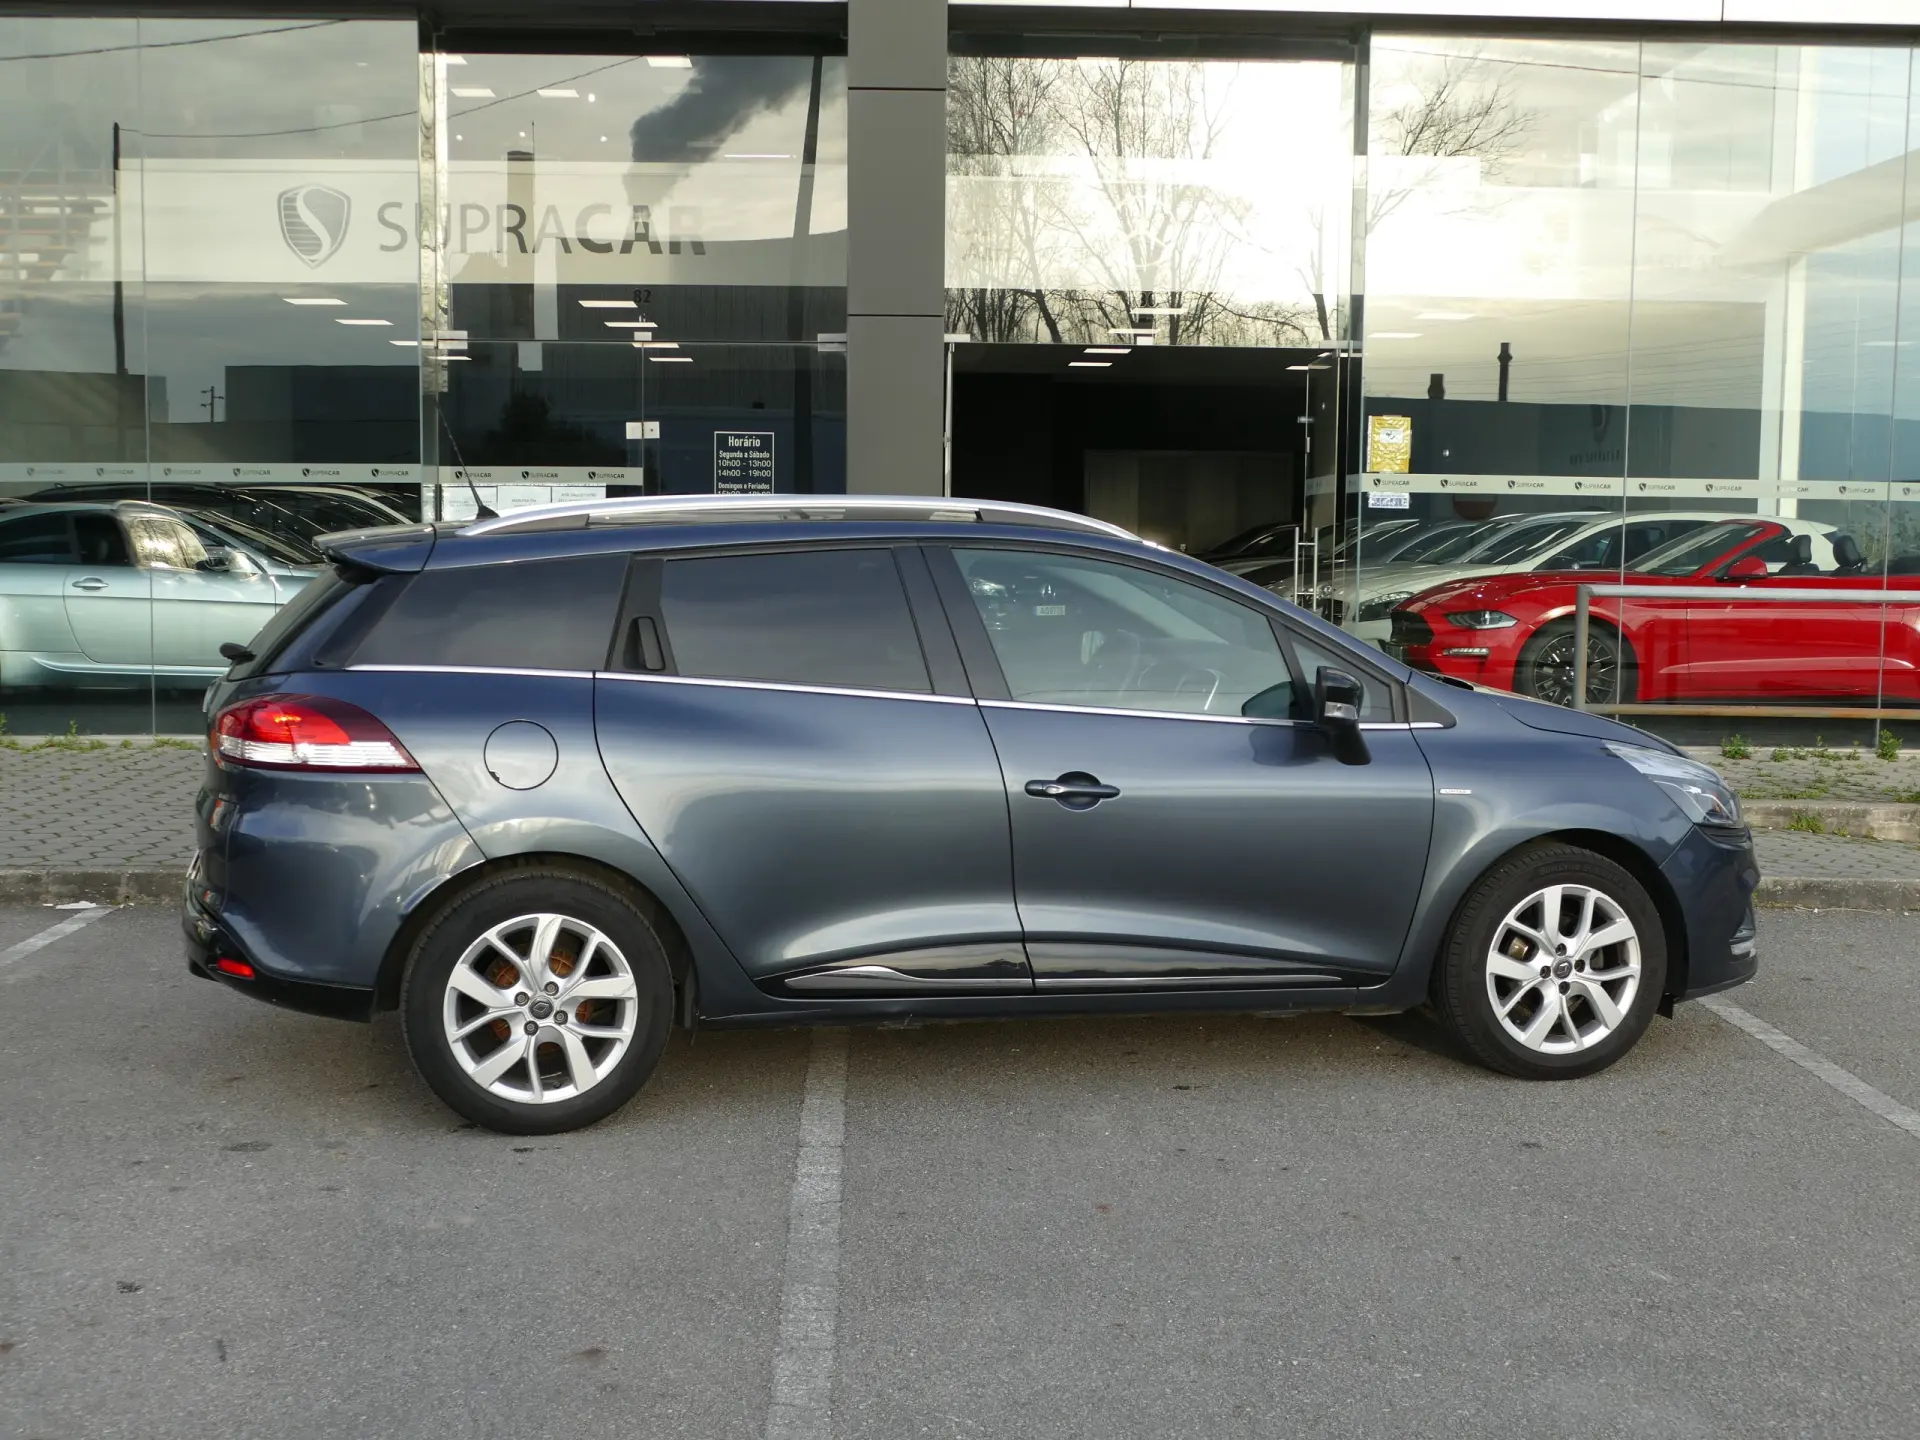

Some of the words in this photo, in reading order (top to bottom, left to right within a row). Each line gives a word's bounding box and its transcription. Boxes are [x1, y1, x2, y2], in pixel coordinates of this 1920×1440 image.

[633, 288, 652, 304] 82
[728, 435, 761, 447] Horário
[719, 450, 743, 459] Segunda
[749, 450, 770, 458] Sábado
[717, 459, 741, 467] 10h00
[717, 469, 741, 477] 14h00
[748, 469, 772, 477] 19h00
[718, 482, 743, 490] Domingos
[748, 482, 770, 490] Feriados
